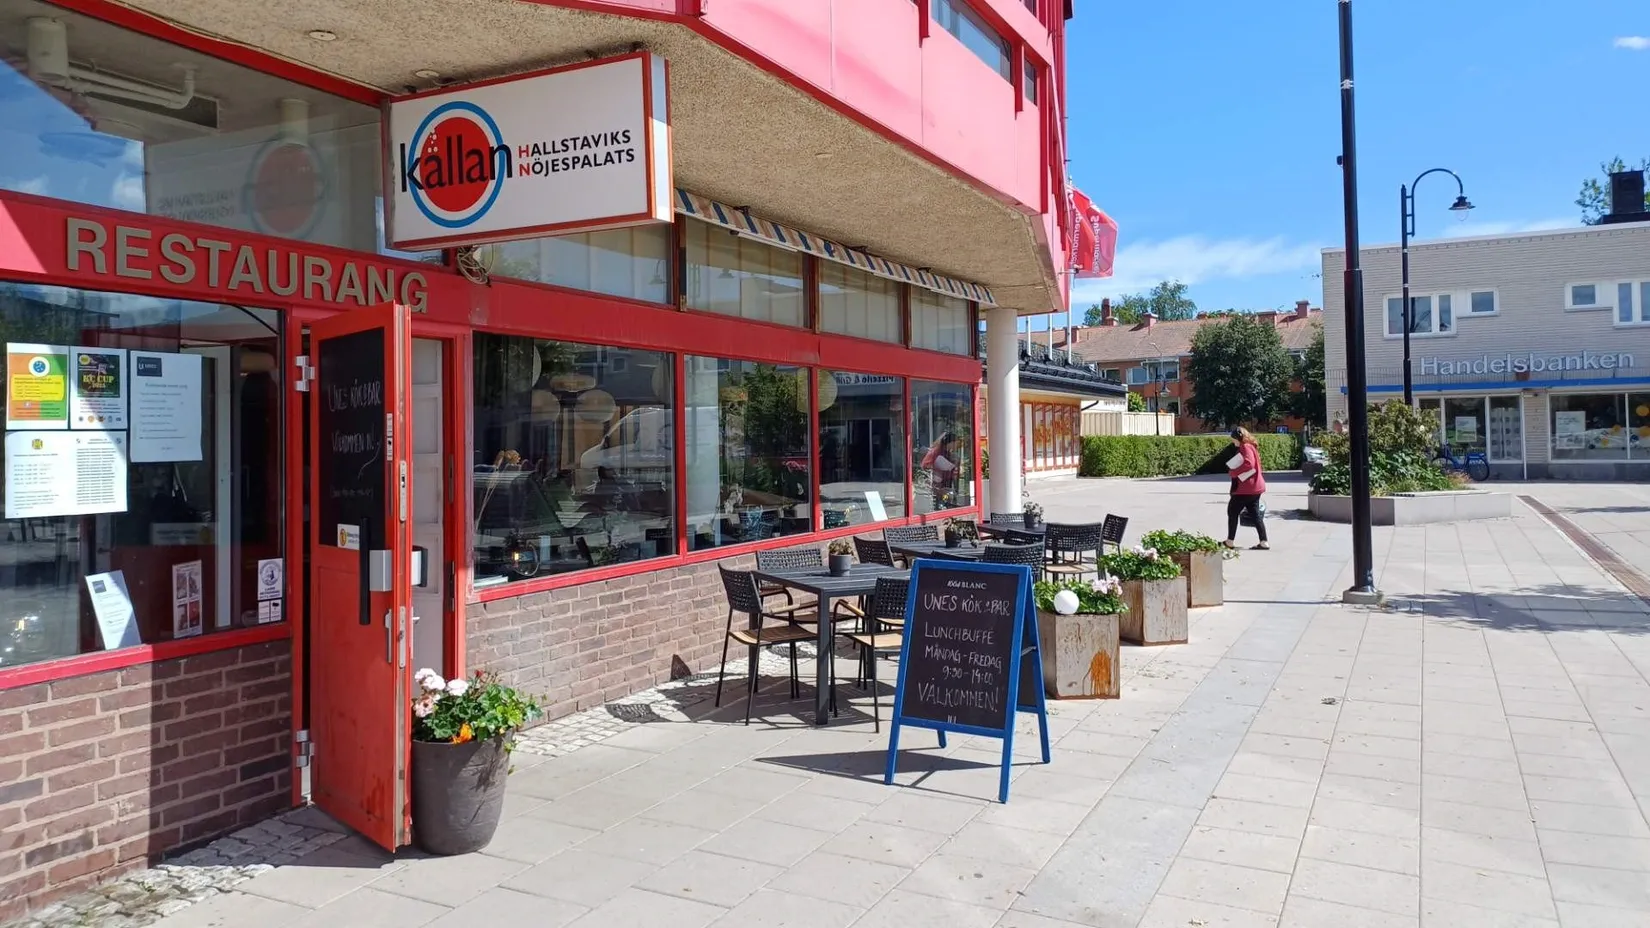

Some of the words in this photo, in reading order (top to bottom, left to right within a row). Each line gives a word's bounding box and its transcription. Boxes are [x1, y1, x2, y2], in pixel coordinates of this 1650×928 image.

[518, 129, 632, 158] HALLSTAVIKS
[400, 131, 513, 192] källan
[518, 147, 635, 177] NÖJESPALATS
[66, 216, 429, 314] RESTAURANG
[1420, 350, 1635, 376] Handelsbanken
[961, 581, 988, 590] BLANC
[924, 593, 958, 612] UNES
[961, 594, 982, 614] KÖK
[990, 599, 1011, 617] BAR
